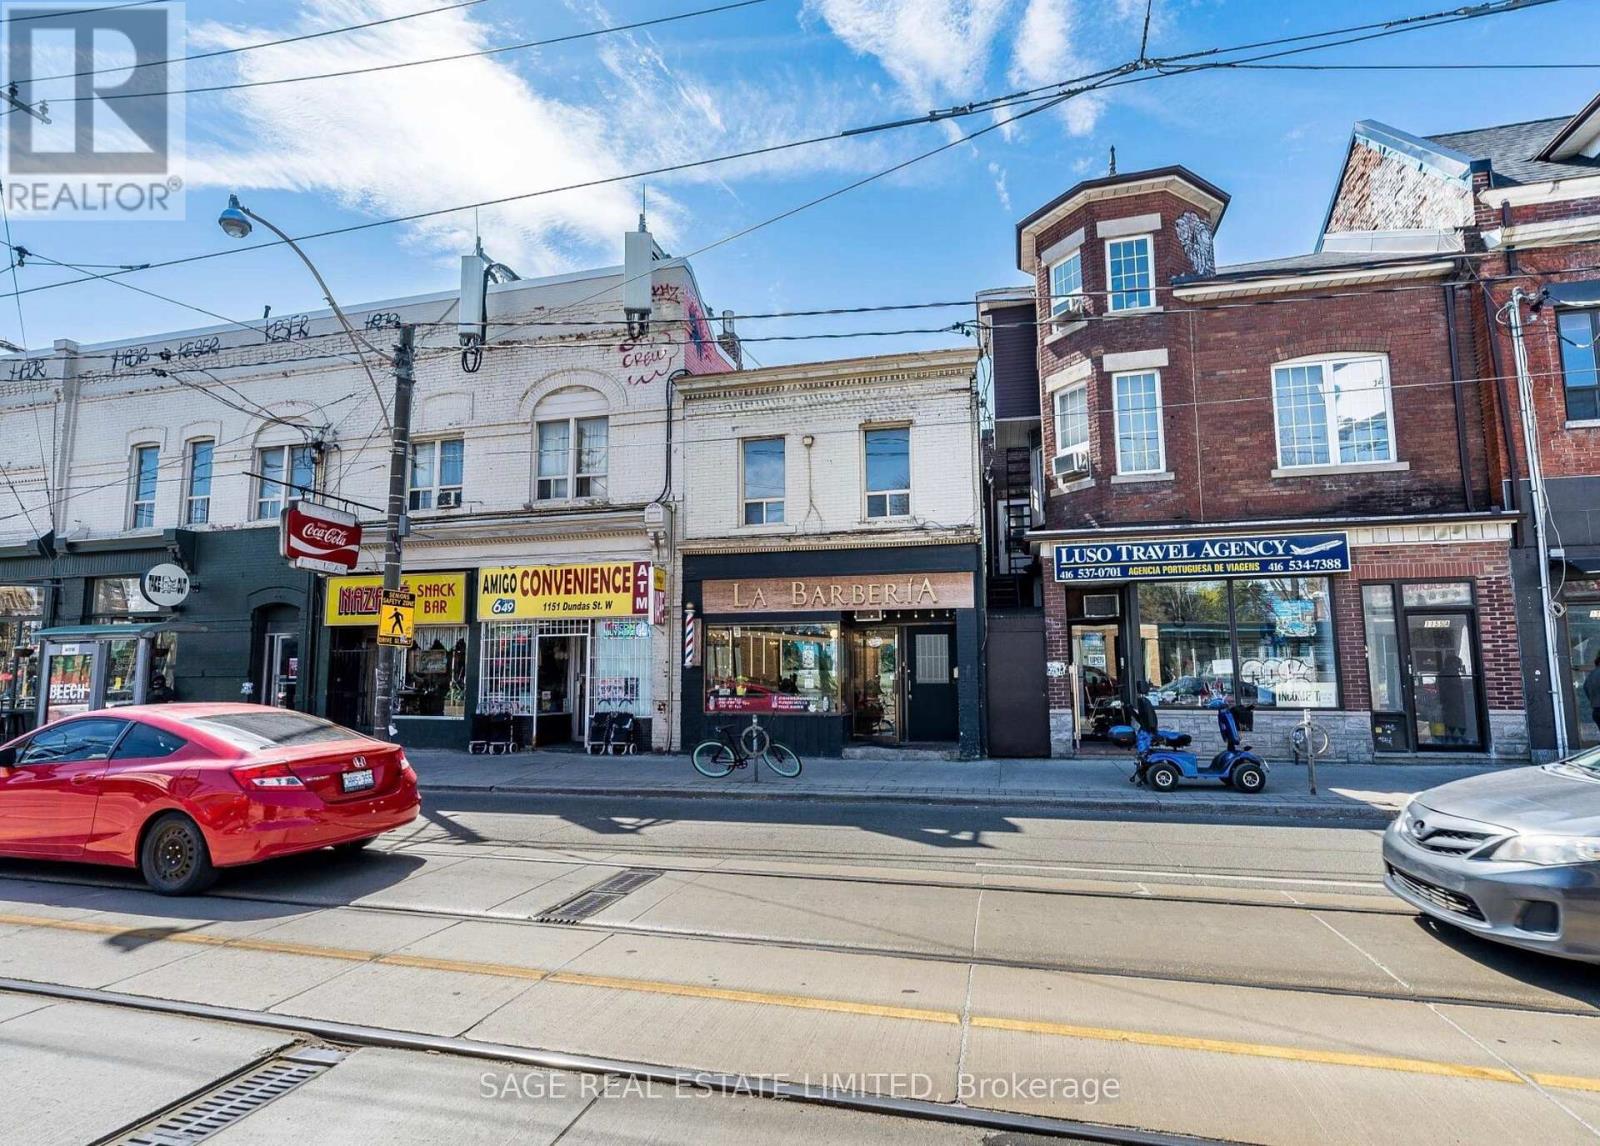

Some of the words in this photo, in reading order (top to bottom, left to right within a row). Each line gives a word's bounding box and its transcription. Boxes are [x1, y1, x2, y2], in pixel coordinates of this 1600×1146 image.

[302, 522, 349, 546] Coca-Cola
[1060, 546, 1112, 564] LUSO
[1116, 543, 1196, 562] TRAVEL
[1199, 539, 1288, 558] AGENCY
[1128, 566, 1161, 576] AGENCIA
[1162, 563, 1213, 575] PORTUGUESA
[1214, 563, 1225, 573] DE
[1227, 561, 1260, 572] VIAGENS
[1267, 562, 1284, 571] 416
[1288, 558, 1342, 571] 534-7388
[1060, 570, 1074, 579] 416
[1077, 567, 1122, 578] 537-0701
[482, 573, 518, 595] AMIGO
[519, 565, 632, 598] CONVENIENCE
[636, 564, 648, 610] ATM
[389, 591, 411, 600] SENIORS
[417, 583, 456, 598] SNACK
[424, 600, 447, 614] BAR
[543, 601, 561, 612] 1151
[562, 602, 590, 611] Dundas
[592, 600, 603, 610] St.
[605, 600, 613, 610] W
[50, 683, 85, 699] BEECH
